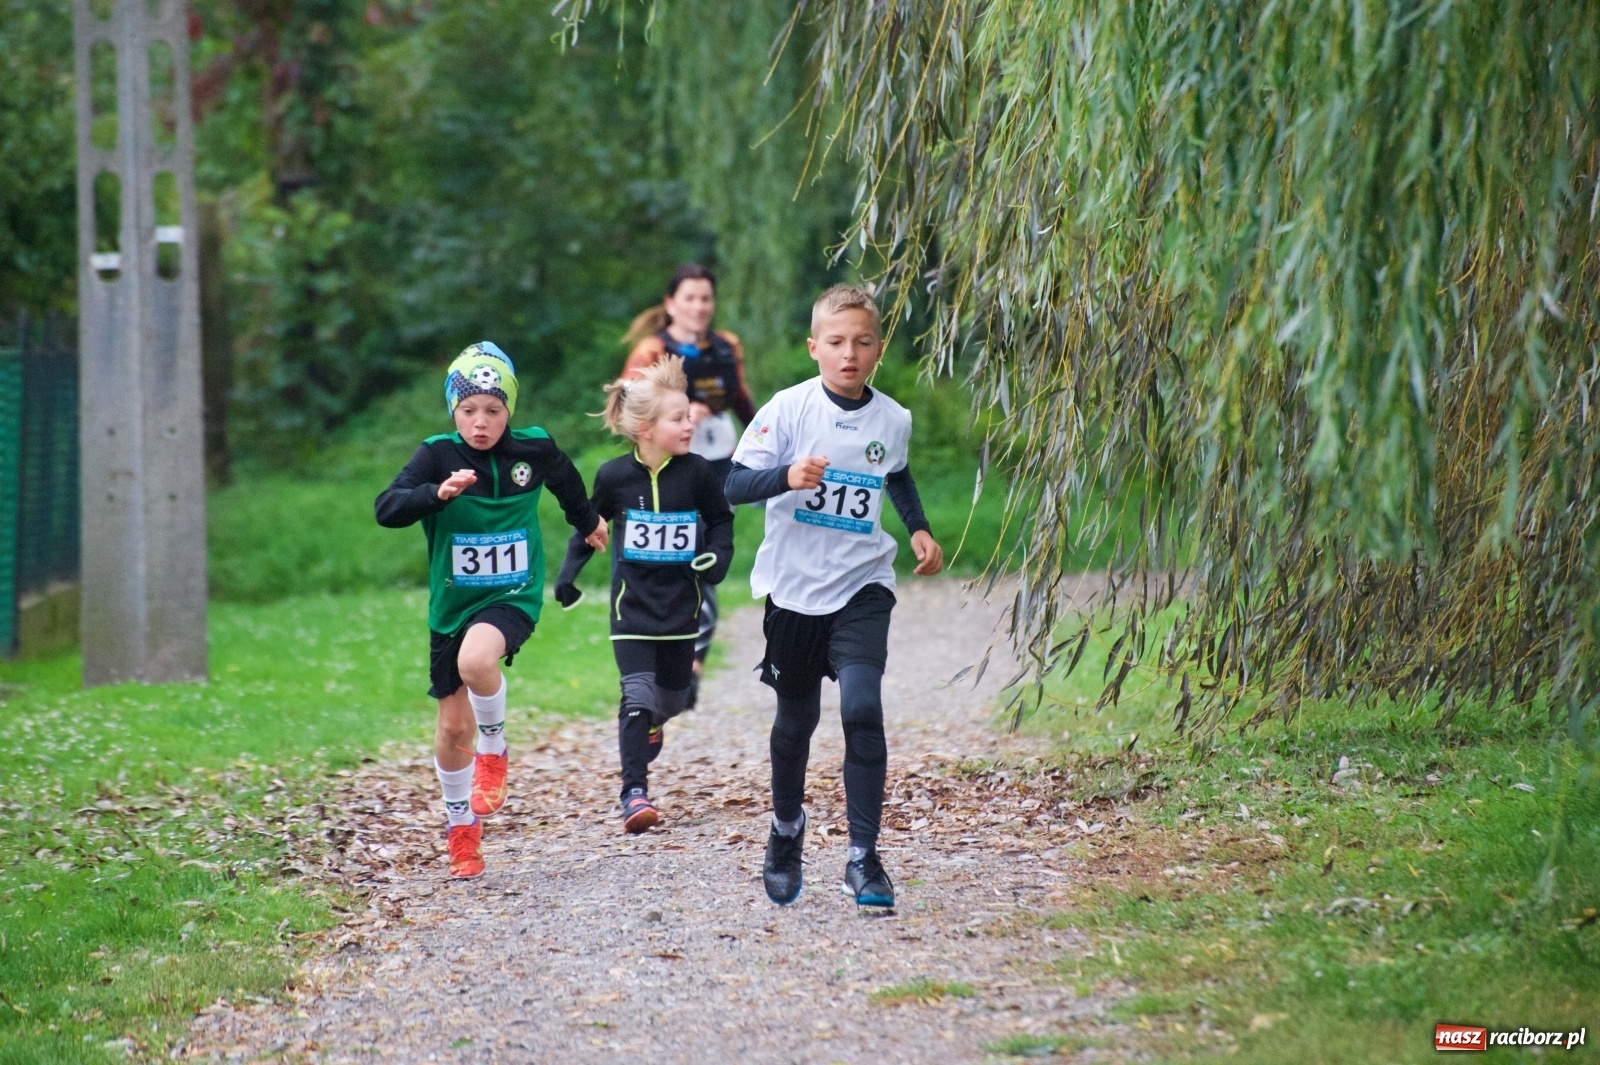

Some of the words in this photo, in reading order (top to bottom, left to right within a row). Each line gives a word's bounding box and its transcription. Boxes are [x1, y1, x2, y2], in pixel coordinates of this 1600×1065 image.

[822, 471, 880, 487] E-SPORT.PL
[805, 481, 871, 519] 313
[632, 523, 689, 551] 315
[461, 544, 516, 575] 311
